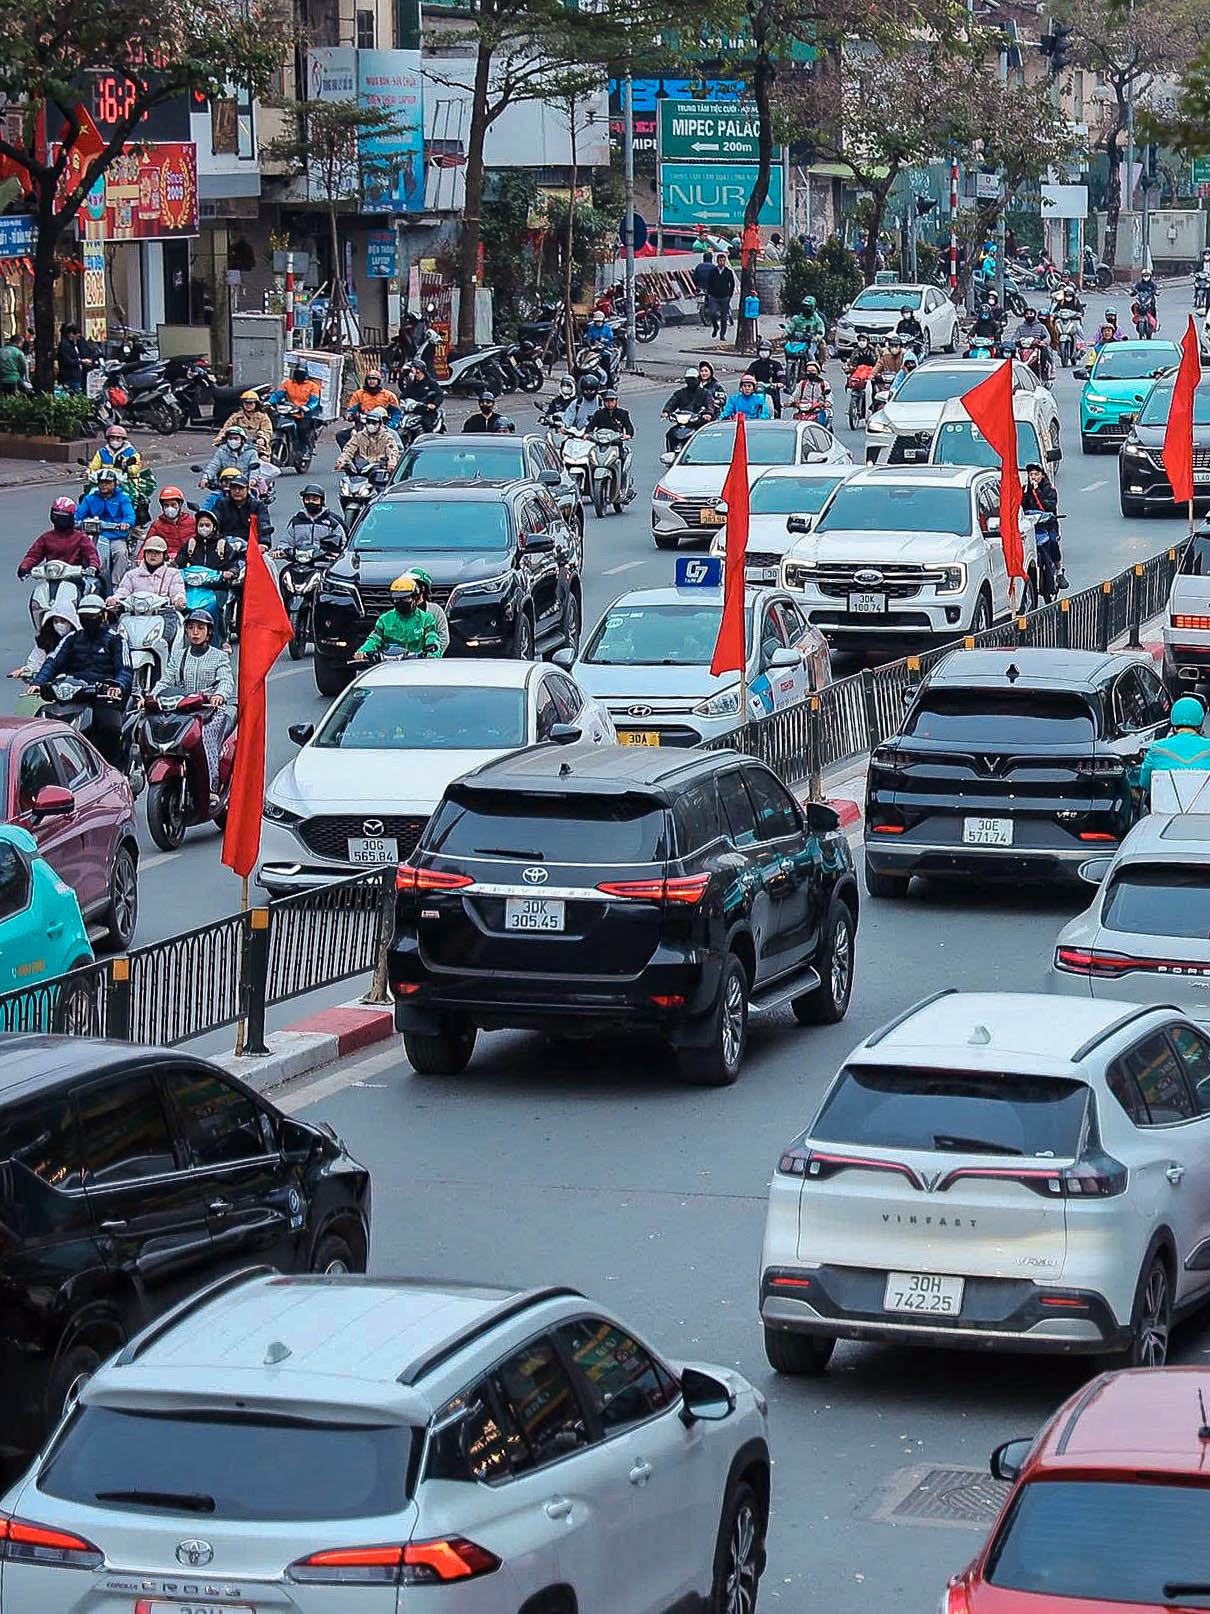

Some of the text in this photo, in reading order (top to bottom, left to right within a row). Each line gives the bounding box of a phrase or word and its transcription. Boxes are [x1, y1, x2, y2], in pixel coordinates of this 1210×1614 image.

[672, 119, 714, 136] MIPEC
[717, 120, 761, 137] PALAC
[722, 142, 753, 152] 200m
[686, 560, 709, 583] G7
[767, 570, 777, 578] 30
[859, 594, 875, 603] 30K
[628, 734, 648, 744] 30A
[977, 819, 999, 832] 30E
[968, 831, 1007, 843] 571.74
[362, 840, 384, 851] 30G
[354, 851, 393, 862] 565.84
[523, 900, 547, 914] 30K
[511, 914, 558, 928] 305.45
[881, 1214, 978, 1228] VINFAST
[908, 1276, 942, 1293] 30H
[894, 1292, 954, 1312] 742.25
[141, 1579, 243, 1598] CROSS
